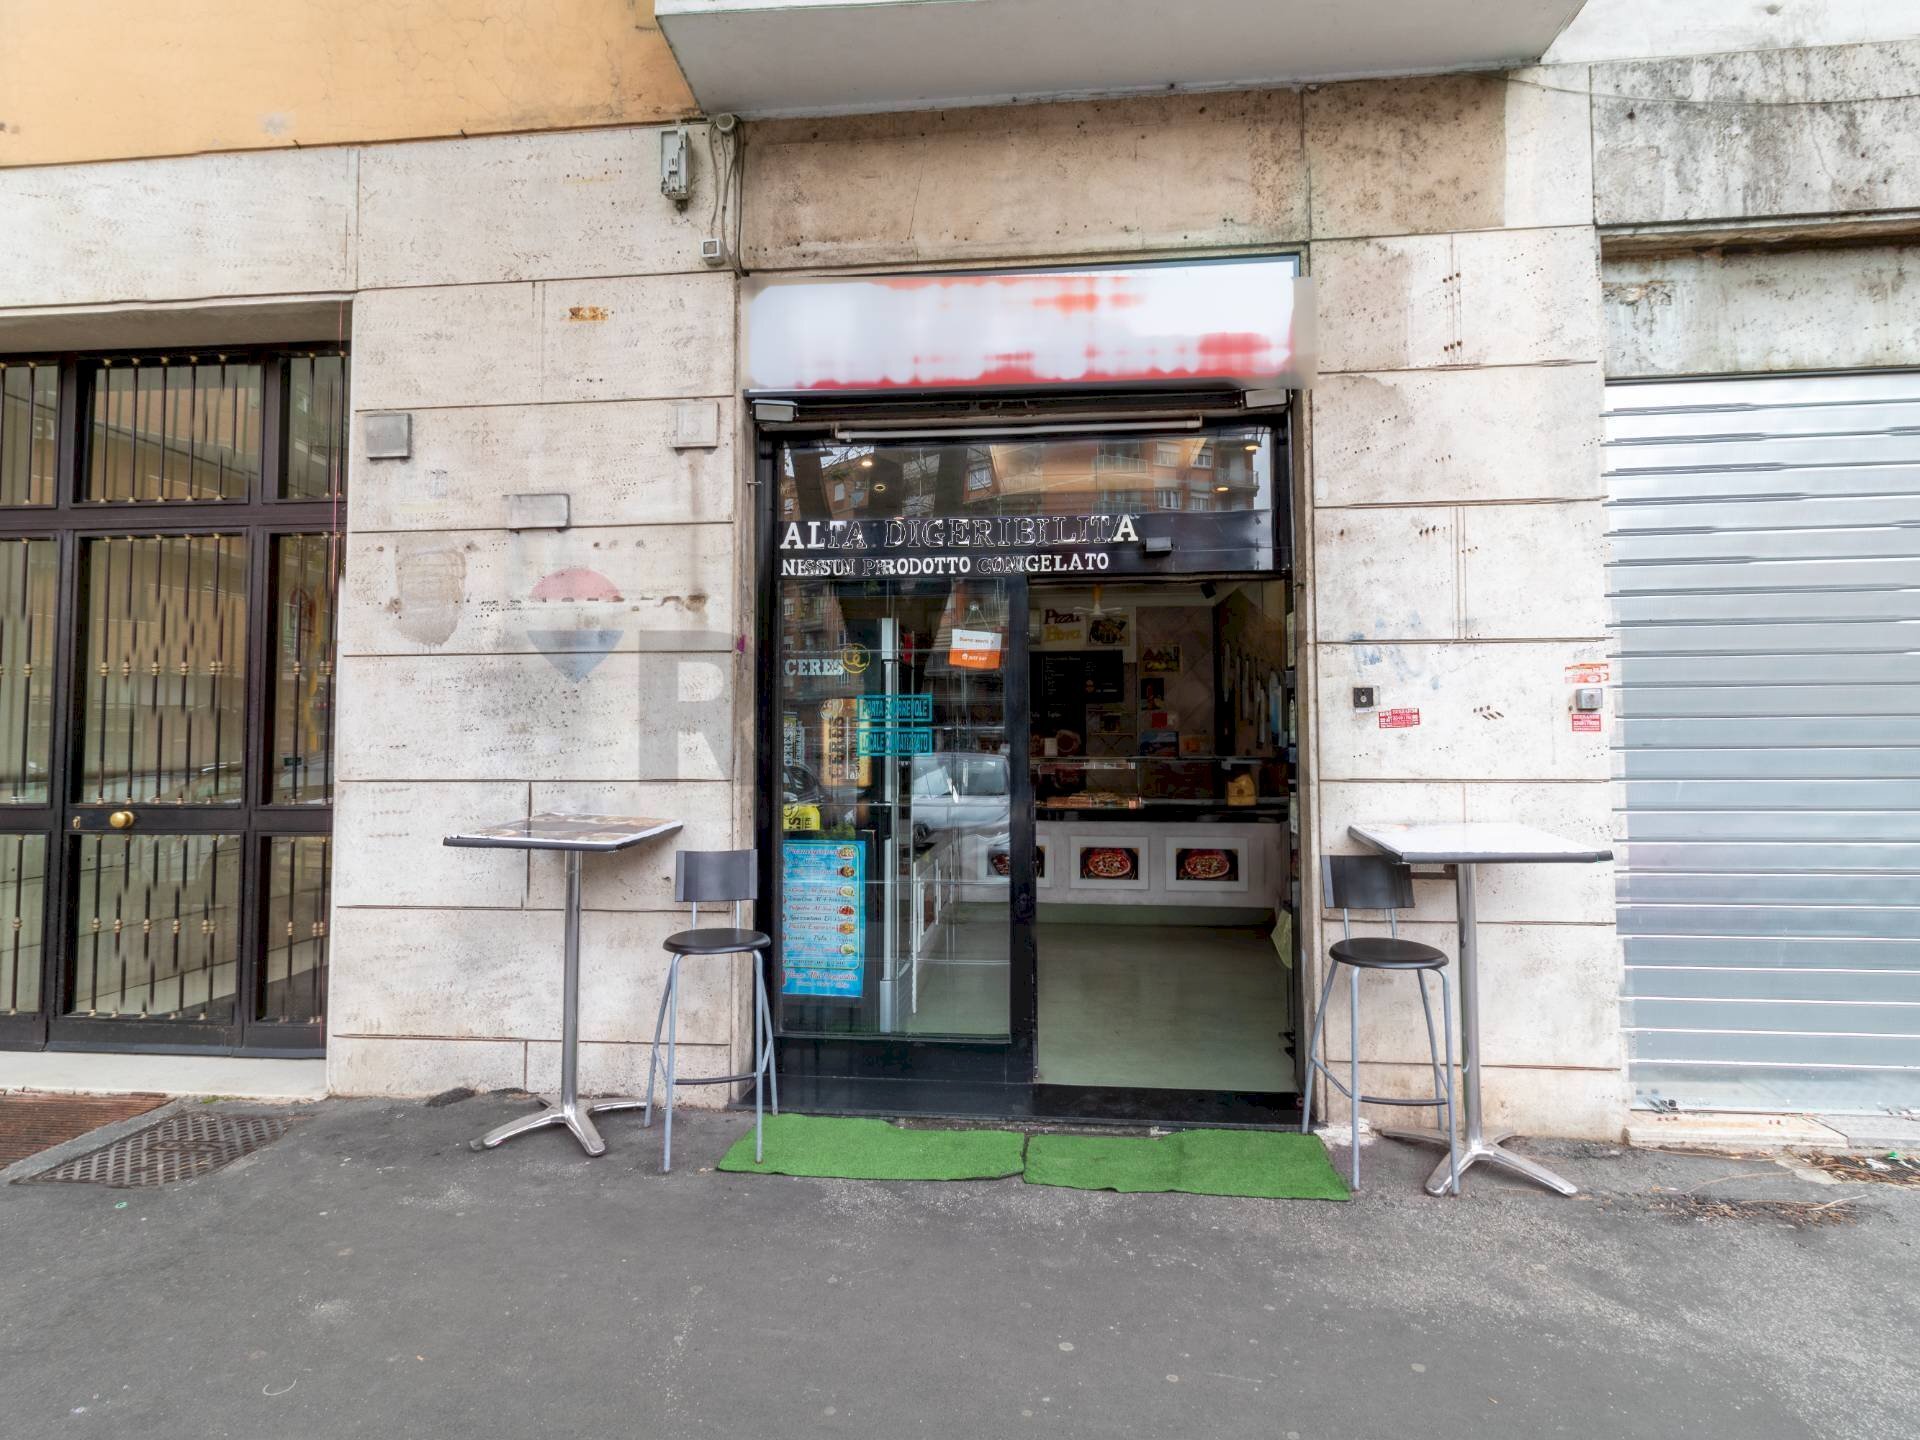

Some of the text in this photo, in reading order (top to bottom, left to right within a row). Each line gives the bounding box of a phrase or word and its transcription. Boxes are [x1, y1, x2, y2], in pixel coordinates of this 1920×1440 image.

[780, 520, 868, 549] ALTA
[862, 556, 971, 577] PRODOTTO
[784, 658, 844, 676] CERES
